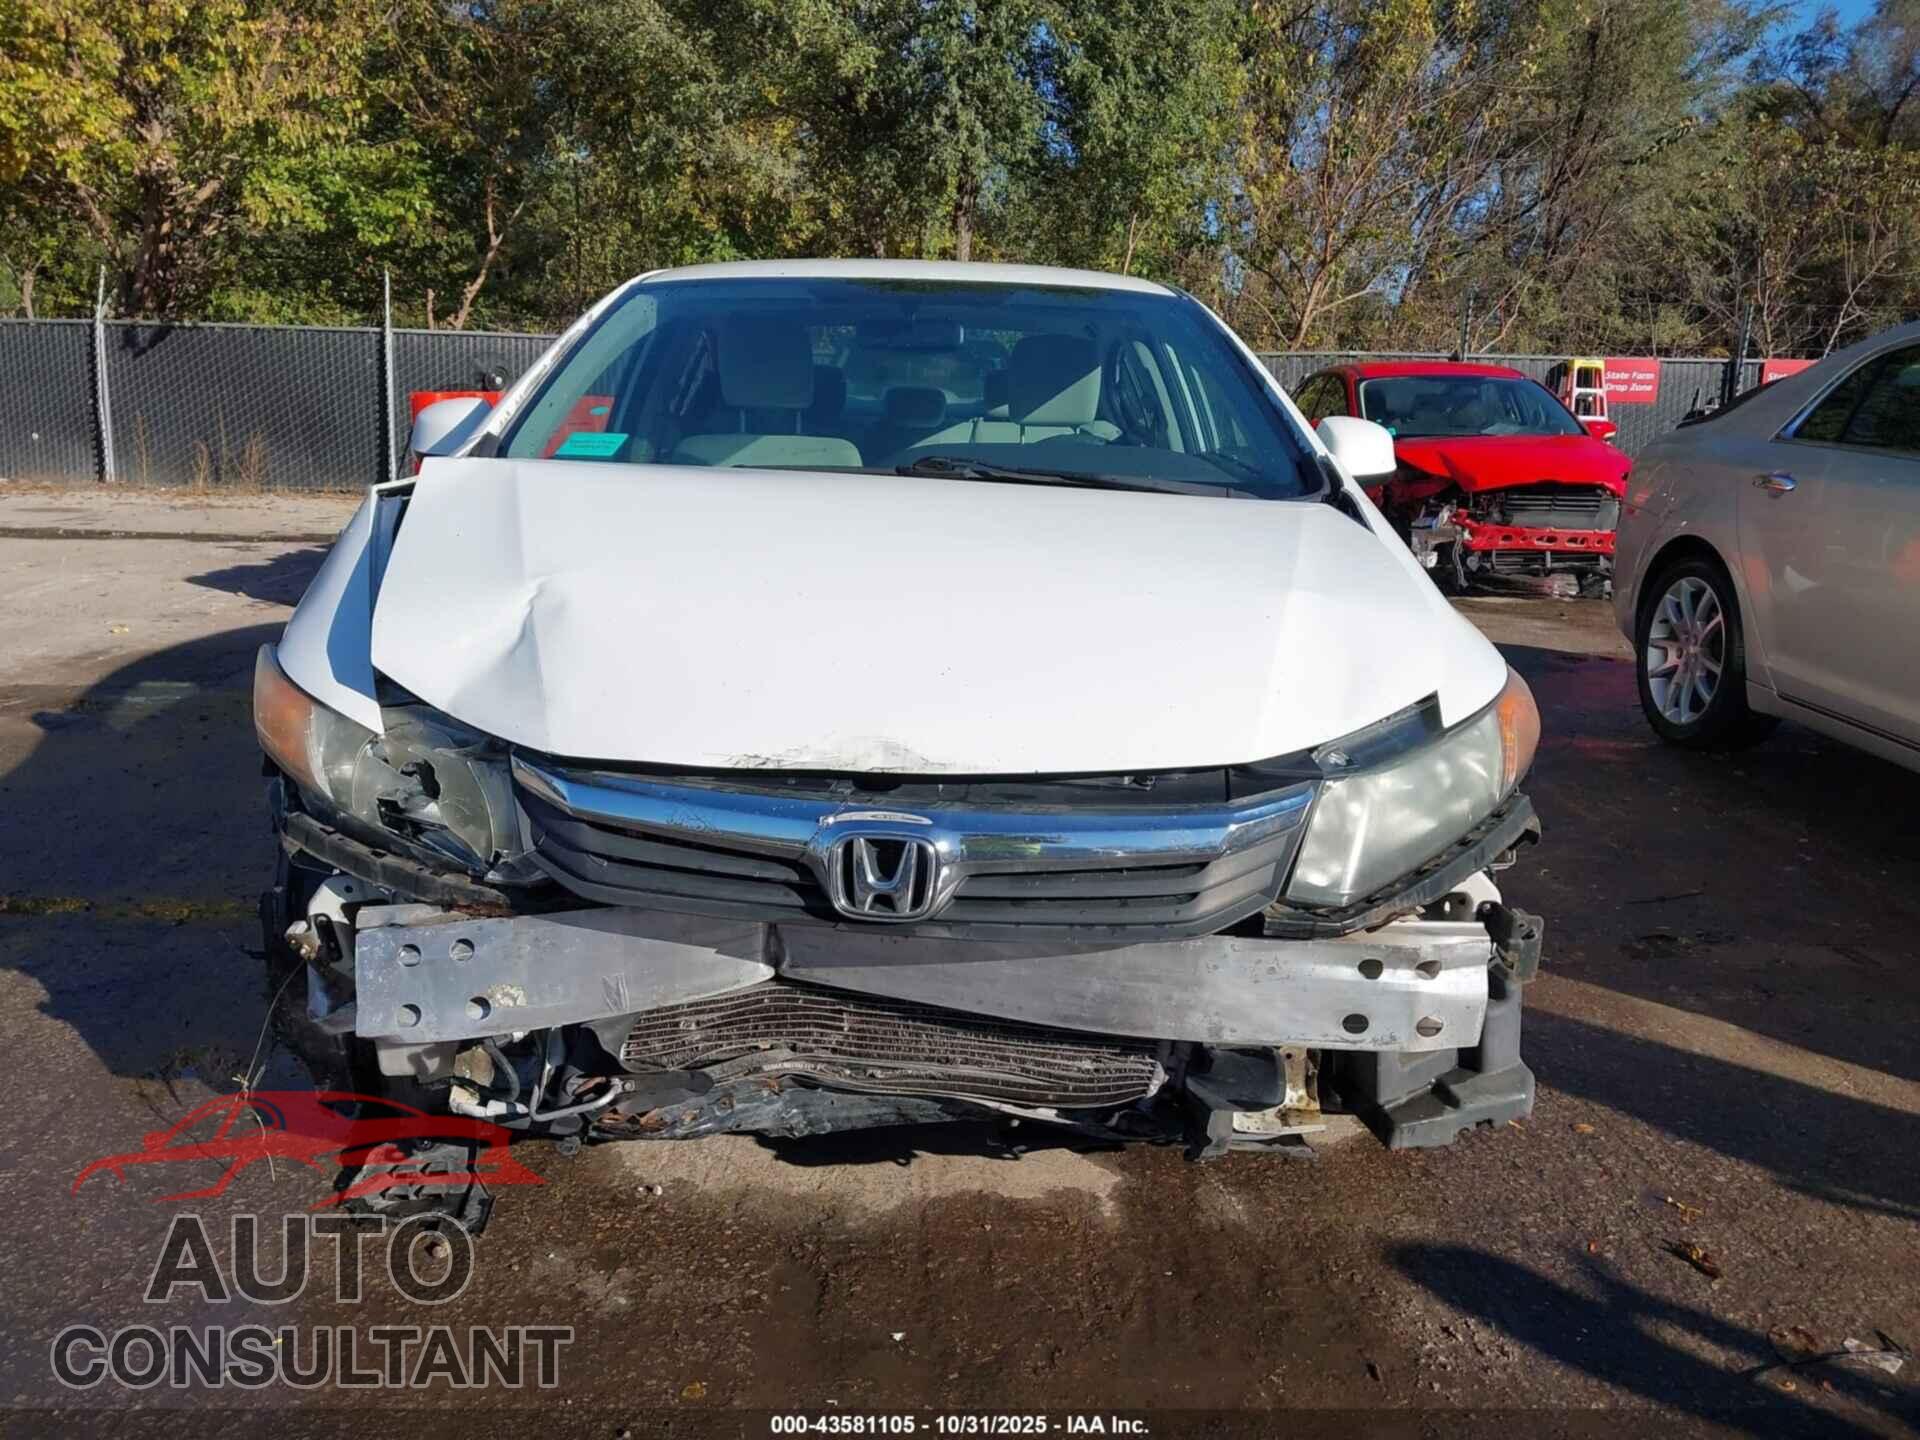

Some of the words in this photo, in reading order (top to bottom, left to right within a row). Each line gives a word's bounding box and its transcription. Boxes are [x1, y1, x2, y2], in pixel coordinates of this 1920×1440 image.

[1606, 371, 1630, 380] State
[1632, 371, 1655, 380] Farm
[1606, 384, 1628, 392] Drop
[1630, 384, 1653, 392] Zone
